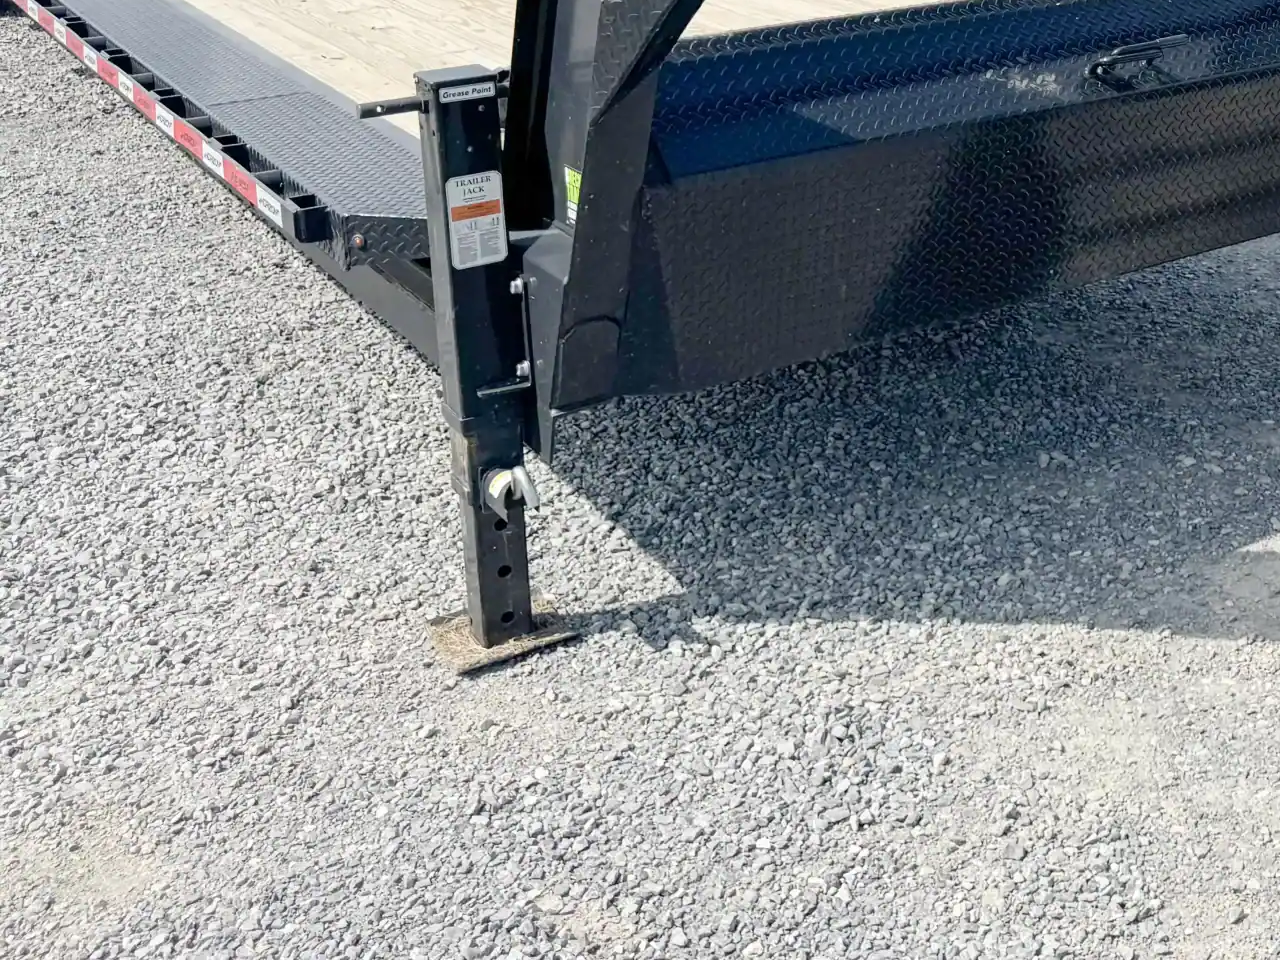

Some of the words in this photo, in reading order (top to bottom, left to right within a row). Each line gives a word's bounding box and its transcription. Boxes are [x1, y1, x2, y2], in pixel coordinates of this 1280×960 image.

[442, 90, 470, 99] Grease
[471, 86, 492, 95] Point
[455, 175, 492, 188] TRAILER
[463, 186, 485, 197] JACK
